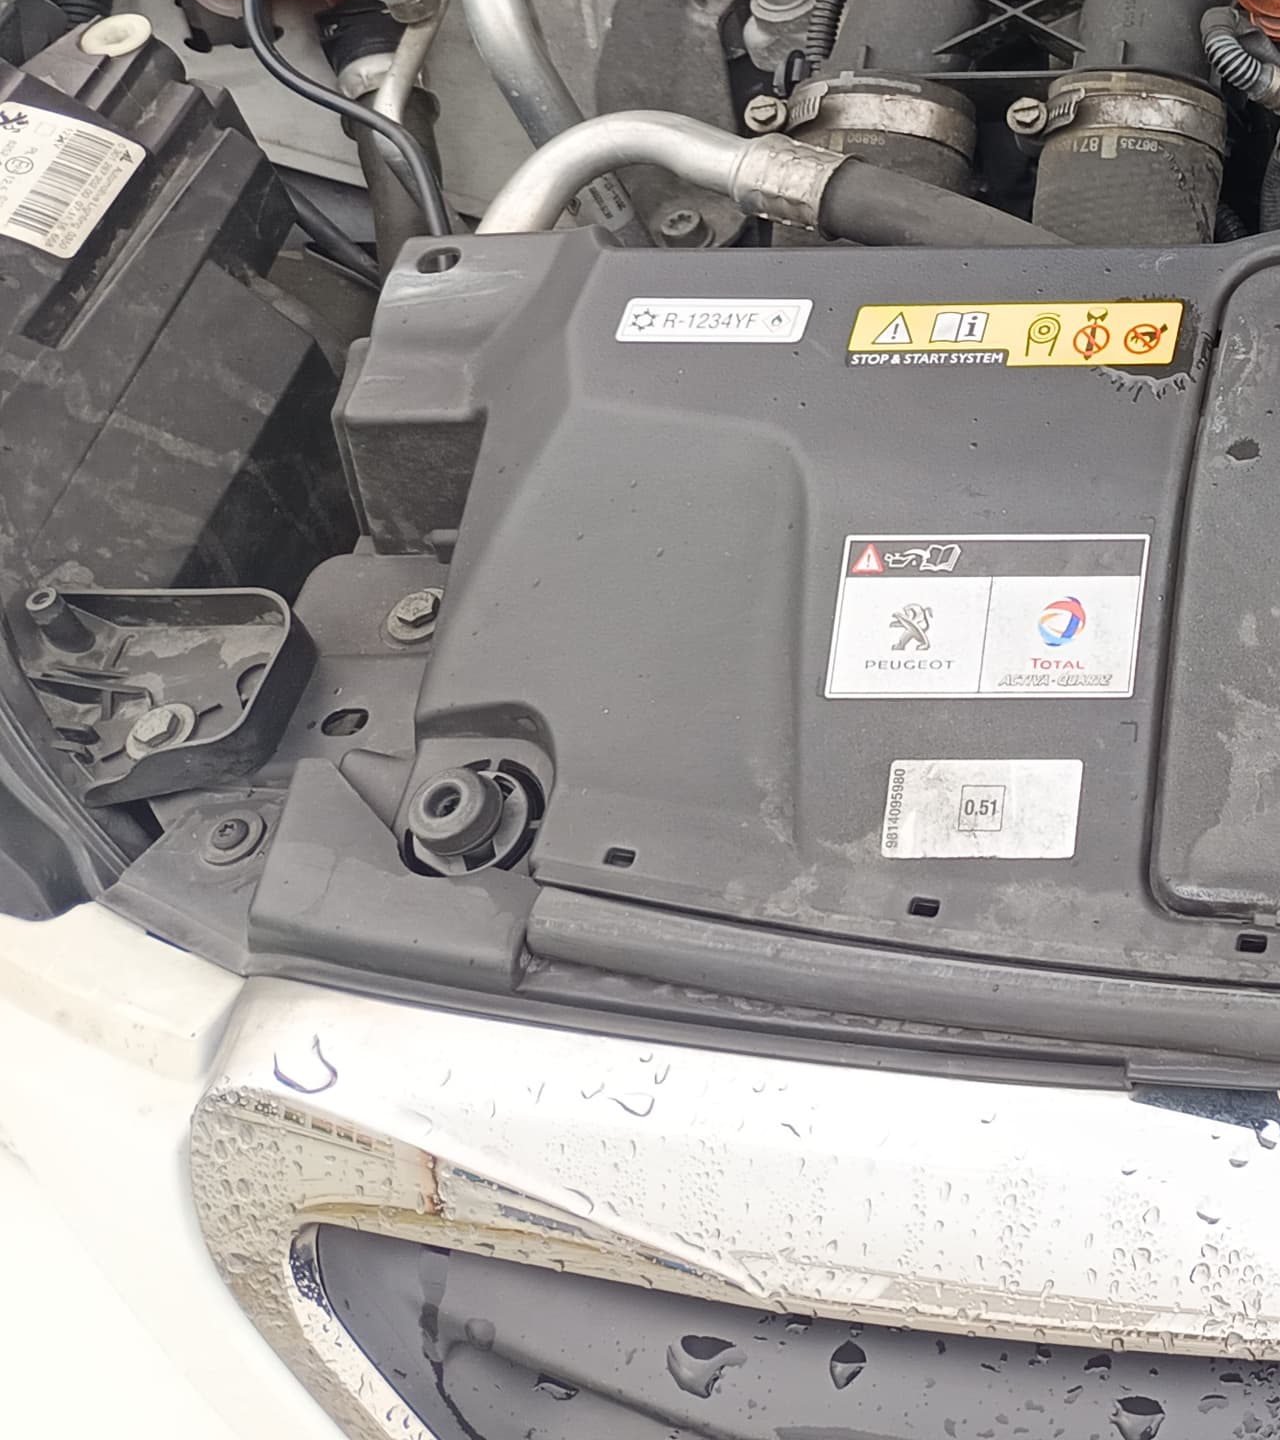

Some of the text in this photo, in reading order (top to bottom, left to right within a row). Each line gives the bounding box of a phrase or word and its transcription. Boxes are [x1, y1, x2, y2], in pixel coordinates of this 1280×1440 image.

[662, 312, 759, 329] R-1234YF
[850, 351, 1004, 366] STOP & START SYSTEM
[864, 659, 956, 671] PEUGEOT
[885, 768, 907, 849] 9814095980
[964, 799, 998, 816] 0.51
